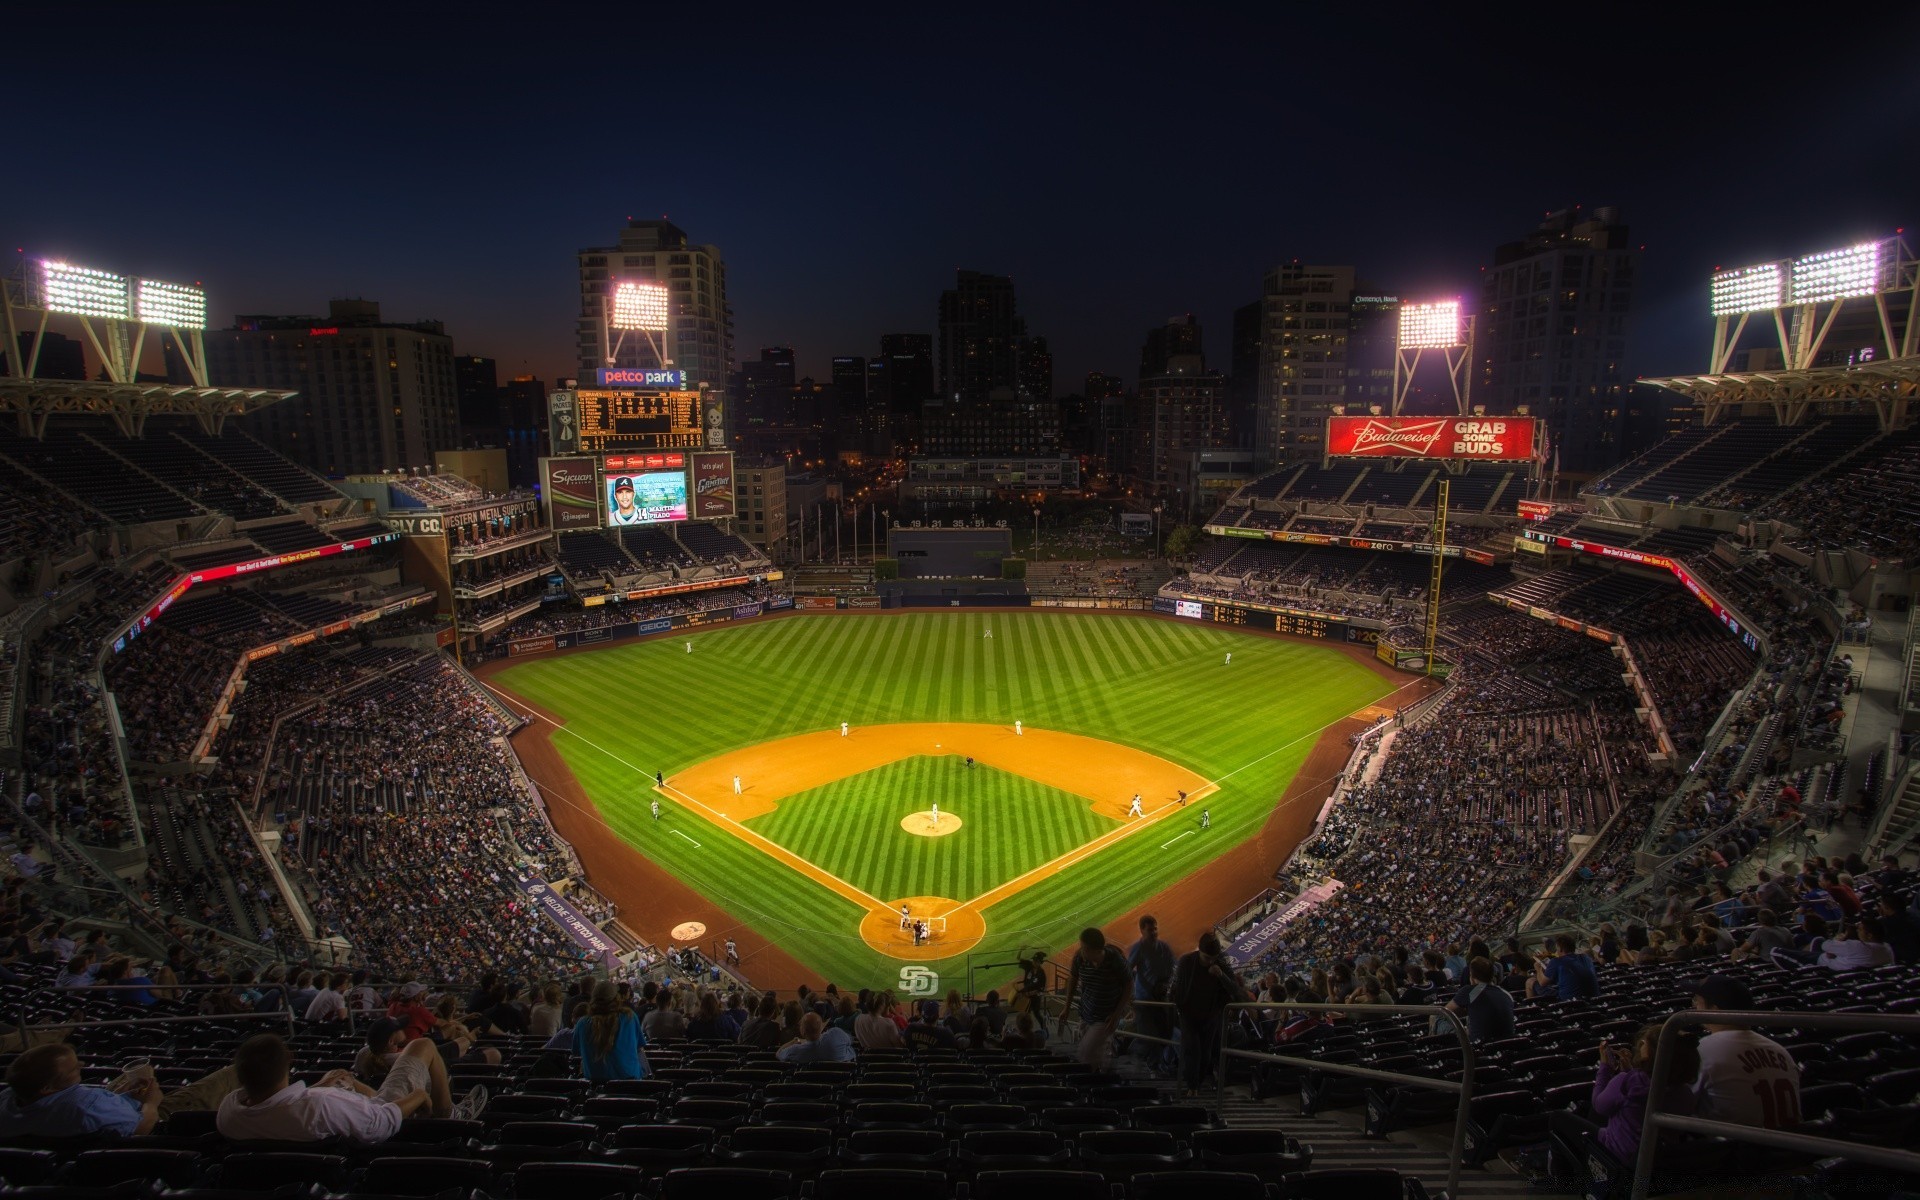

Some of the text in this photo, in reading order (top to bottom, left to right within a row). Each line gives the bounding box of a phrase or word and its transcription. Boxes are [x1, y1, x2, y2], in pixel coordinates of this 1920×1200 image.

[605, 371, 643, 384] petco
[646, 371, 674, 384] park
[1354, 422, 1506, 443] Budweiser GRAB
[1463, 434, 1496, 442] SOME
[1453, 442, 1504, 454] BUDS
[552, 470, 593, 485] Sycuan
[446, 511, 477, 528] WESTERN
[480, 507, 501, 521] METAL
[503, 502, 524, 516] SUPPLY
[637, 507, 647, 520] 14
[420, 519, 445, 532] CO.
[1350, 539, 1393, 550] Coke zero
[849, 597, 878, 608] Sycuan
[736, 604, 760, 617] Ashford
[640, 621, 671, 632] GEICO
[297, 633, 315, 644] TOYOTA
[520, 639, 554, 649] snapdragon
[258, 646, 278, 657] TOYOTA
[543, 895, 609, 952] WELCOME TO PETCO PARK
[1239, 900, 1310, 952] SAN DIEGO PADRES
[899, 966, 939, 995] SD
[1738, 1048, 1789, 1073] JONES
[1753, 1078, 1801, 1130] 10
